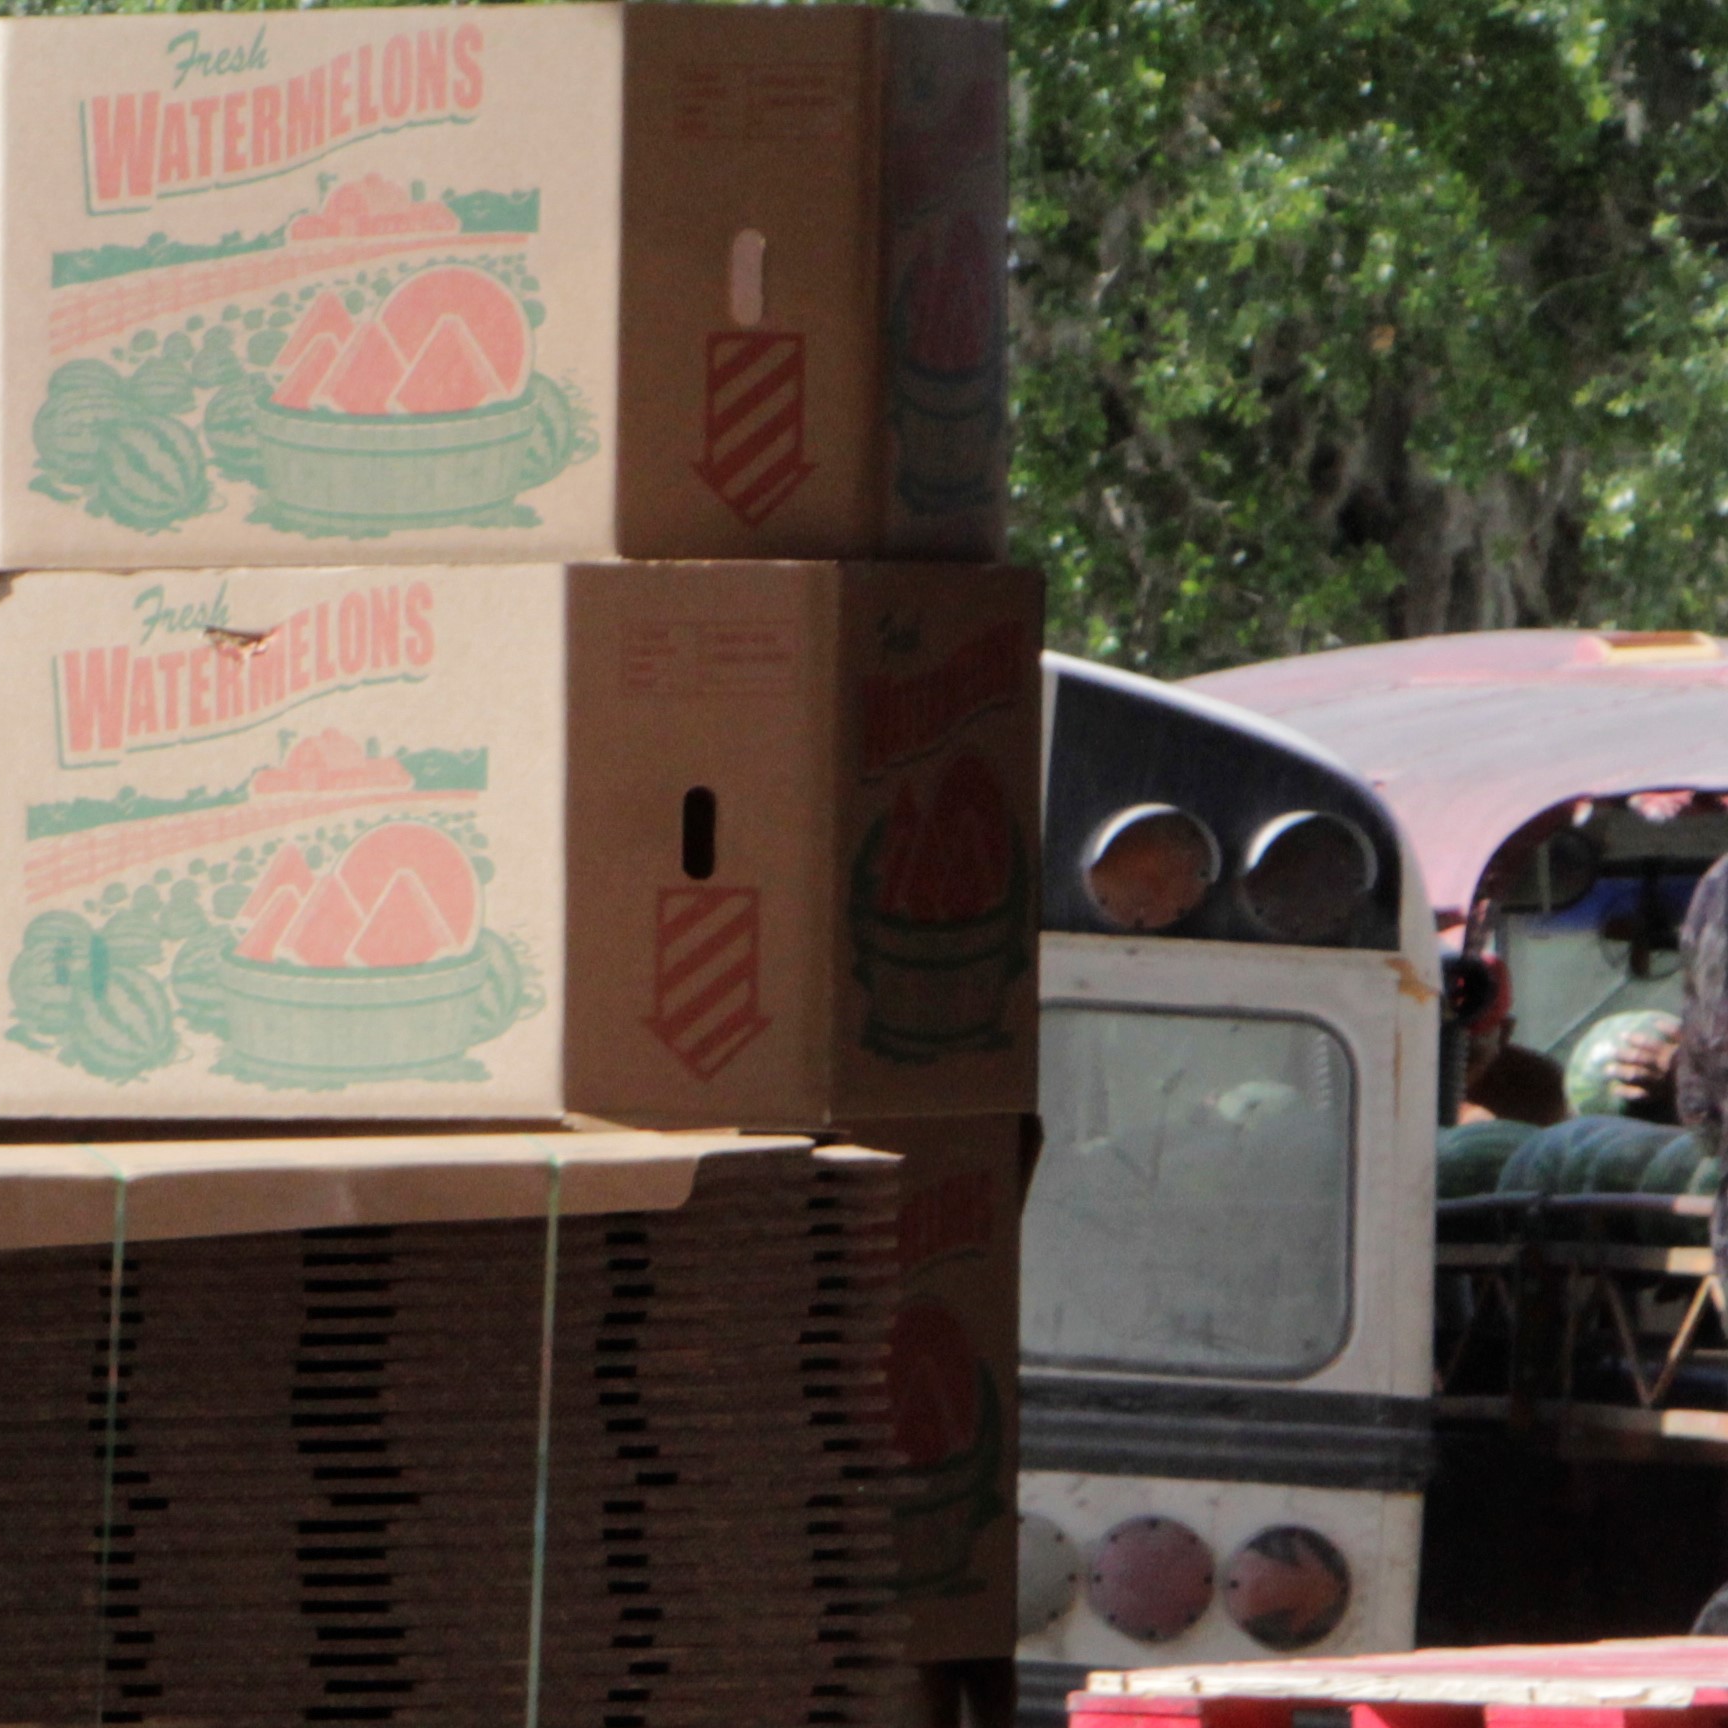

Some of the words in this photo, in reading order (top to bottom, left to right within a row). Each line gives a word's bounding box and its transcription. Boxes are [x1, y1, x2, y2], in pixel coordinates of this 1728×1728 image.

[167, 26, 271, 84] Fresh
[90, 25, 485, 202] WATERMELONS
[62, 584, 435, 754] WATERMELONS
[133, 582, 232, 645] Fresh
